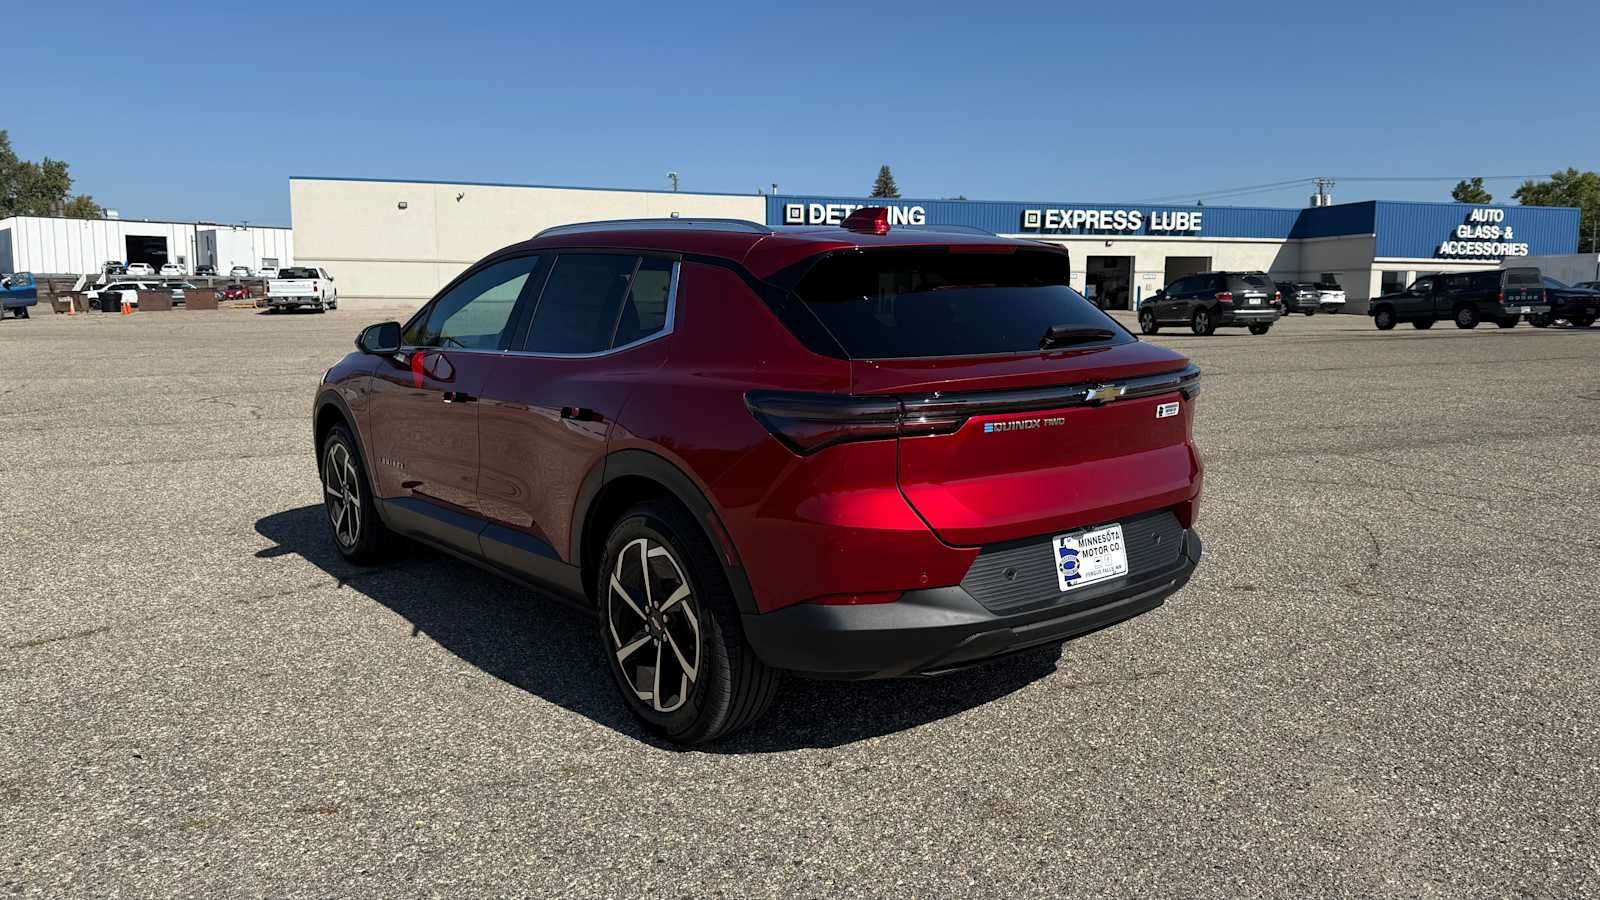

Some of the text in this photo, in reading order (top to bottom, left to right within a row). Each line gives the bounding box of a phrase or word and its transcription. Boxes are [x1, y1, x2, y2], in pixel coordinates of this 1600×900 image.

[809, 204, 925, 225] DETING
[1045, 209, 1203, 231] EXPRESS LUBE
[1470, 208, 1504, 222] AUTO
[1457, 225, 1514, 239] GLASS &
[1439, 241, 1528, 256] ACCESSORIES
[984, 419, 1041, 433] EQUINOX
[1078, 531, 1120, 547] MINNESOTA
[1082, 546, 1109, 558] MOTOR
